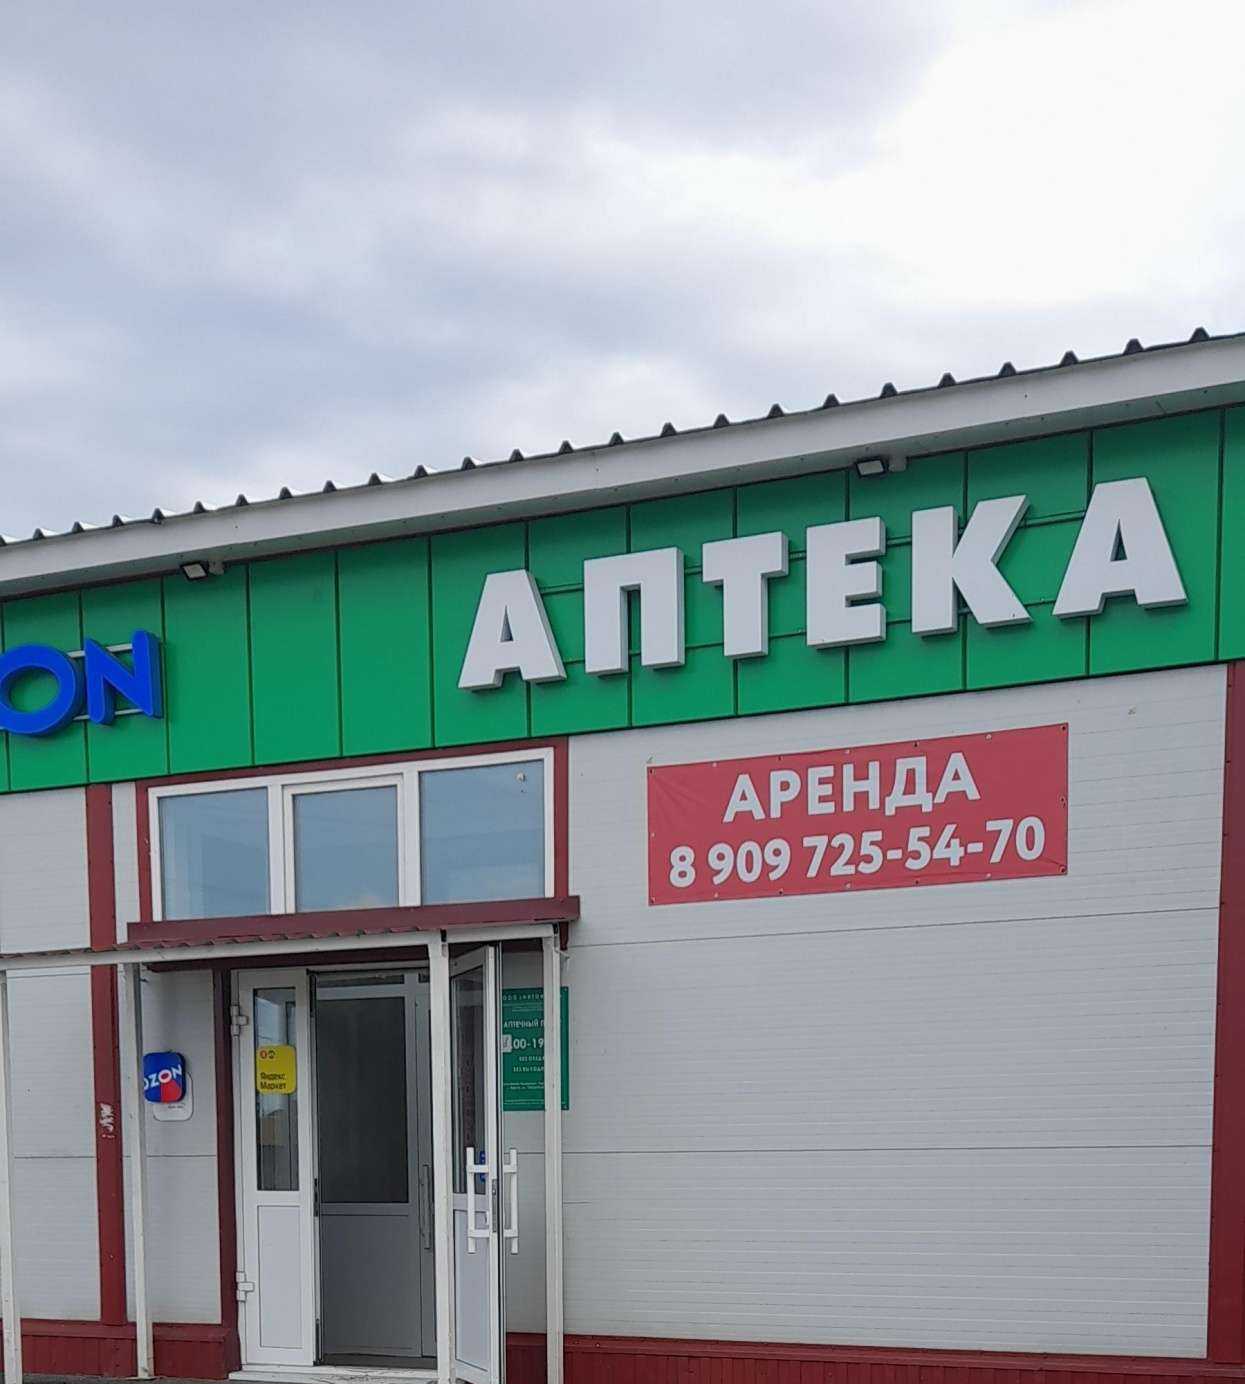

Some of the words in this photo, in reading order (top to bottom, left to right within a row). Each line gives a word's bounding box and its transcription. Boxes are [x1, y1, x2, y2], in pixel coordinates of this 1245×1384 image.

[457, 476, 1188, 691] АПТЕКА
[722, 752, 980, 823] АРЕНДА
[669, 846, 696, 888] 8
[707, 838, 791, 885] 909
[802, 816, 1045, 879] 725-54-70
